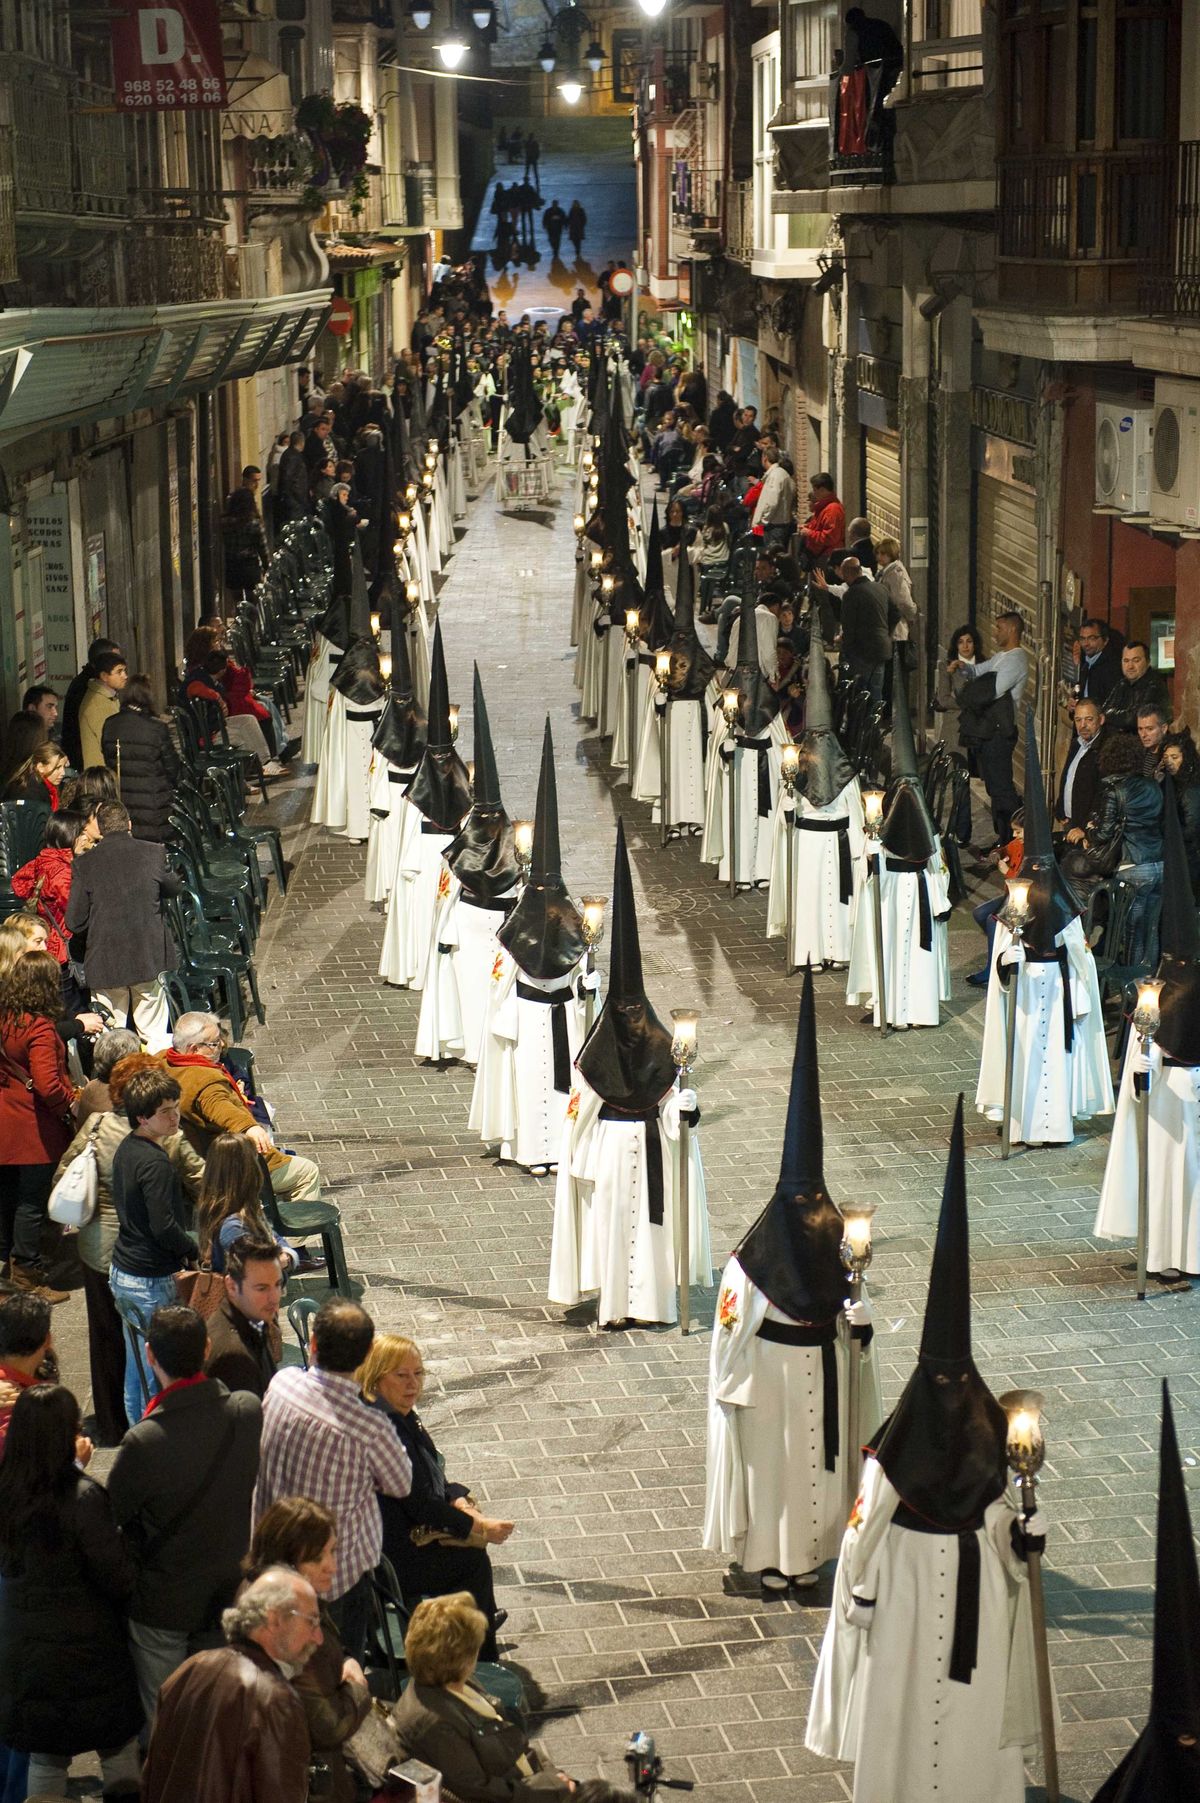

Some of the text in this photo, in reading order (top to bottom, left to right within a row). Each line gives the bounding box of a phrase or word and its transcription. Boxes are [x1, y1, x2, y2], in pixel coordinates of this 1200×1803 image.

[138, 8, 202, 65] D.
[124, 77, 221, 93] 968 52 48 66
[124, 91, 222, 107] 620 90 18 06
